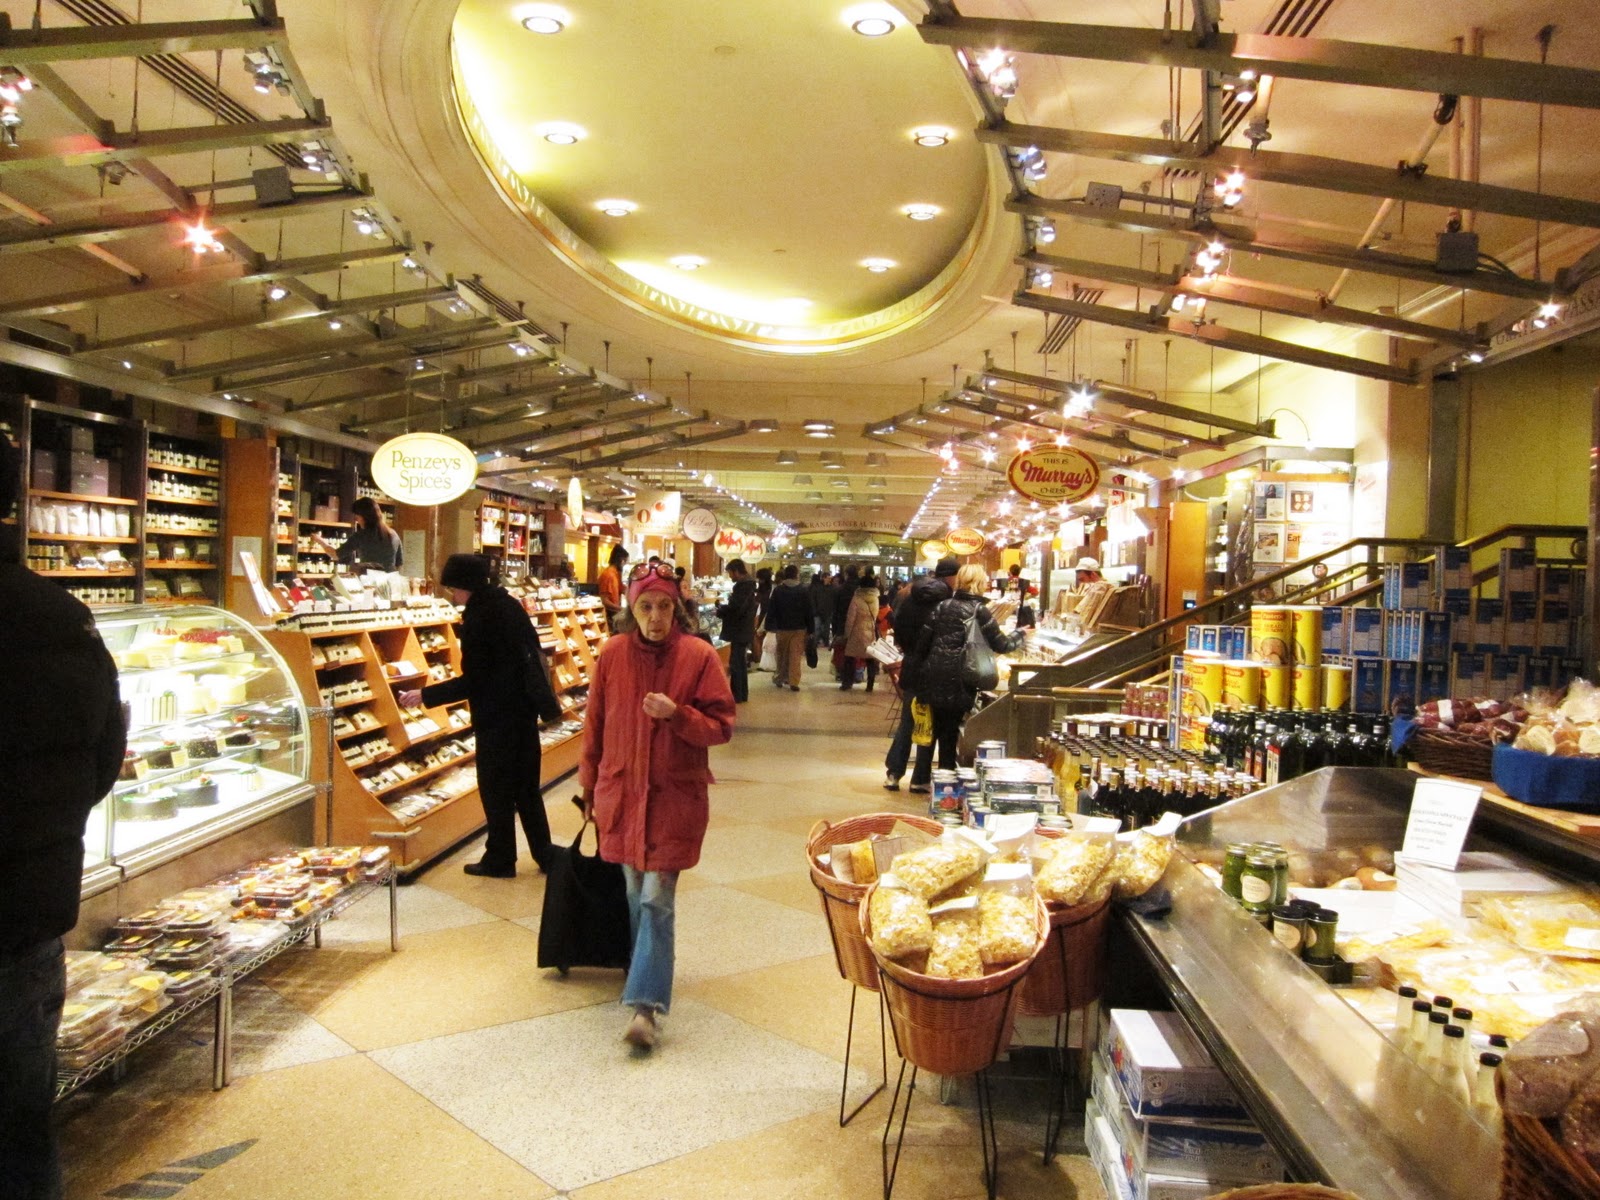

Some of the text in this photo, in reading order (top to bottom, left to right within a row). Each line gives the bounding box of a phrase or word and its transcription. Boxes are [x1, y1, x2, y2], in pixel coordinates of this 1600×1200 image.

[392, 450, 461, 475] Penzeys
[1020, 460, 1093, 490] Murray's
[400, 469, 452, 494] Spices
